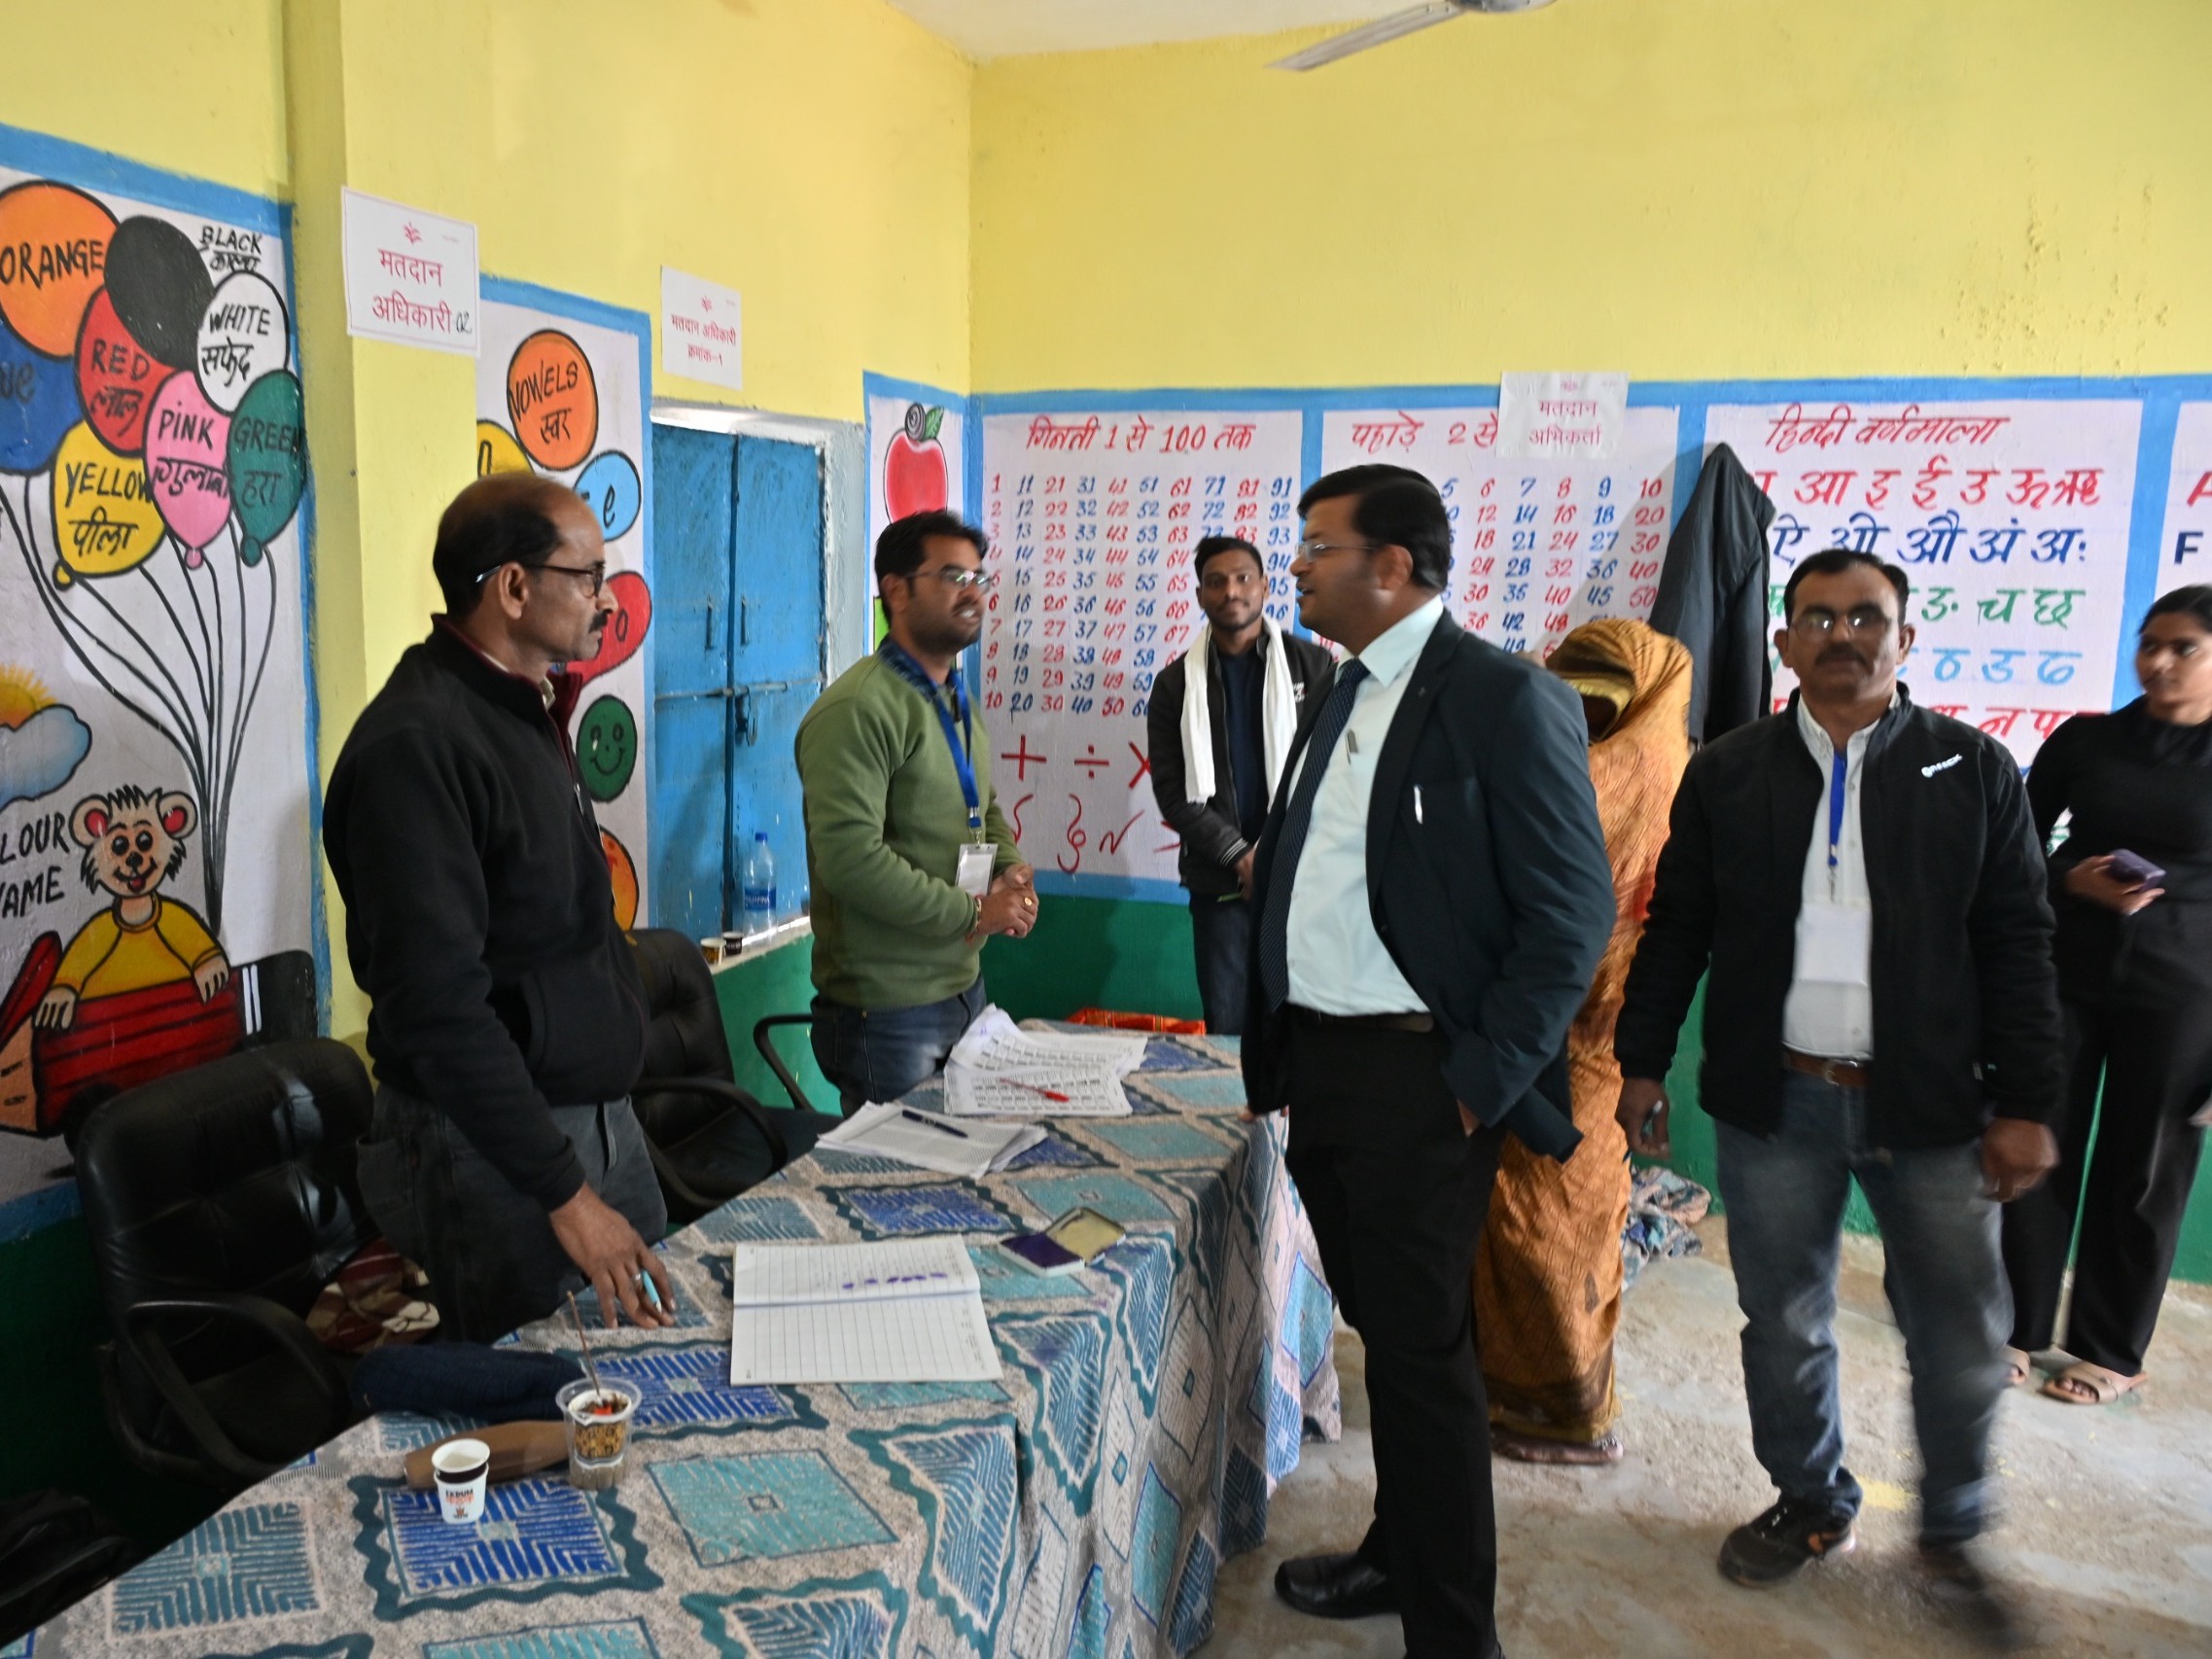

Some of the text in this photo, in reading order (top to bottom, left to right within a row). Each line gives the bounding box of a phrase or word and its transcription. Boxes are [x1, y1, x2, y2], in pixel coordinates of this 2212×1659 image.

[199, 226, 263, 254] BLACK
[0, 238, 104, 289] ORANGE
[377, 248, 443, 287] मतदान
[209, 303, 271, 335] WHITE
[372, 290, 452, 334] अधिकारी
[91, 338, 151, 381] RED
[509, 359, 579, 423] VOWELS
[90, 385, 144, 437] लाल
[541, 406, 573, 443] स्वर
[1539, 400, 1598, 417] मतदान
[234, 416, 305, 459] GREEN
[1026, 413, 1257, 453] गिनती 1 से 100 तक
[1352, 409, 1498, 454] पहाड़े 2 से
[1765, 402, 2011, 453] हिन्दी वर्णमाला
[64, 462, 153, 508] YELLOW
[242, 470, 283, 508] हरा
[1016, 475, 1034, 495] 11
[1044, 475, 1065, 494] 21
[1076, 476, 1096, 494] 31
[1139, 476, 1158, 493] 51
[1171, 476, 1192, 498] 61
[1205, 475, 1226, 496] 71
[1271, 476, 1292, 498] 91
[1441, 477, 1458, 499] 5
[1521, 477, 1536, 497] 7
[1557, 477, 1571, 499] 8
[1598, 476, 1611, 499] 9
[1640, 477, 1663, 499] 10
[1794, 471, 1858, 507] आ
[1865, 469, 1902, 511] इ
[1912, 454, 1953, 511] ई
[1960, 469, 2001, 505] उ
[1016, 499, 1034, 518] 12
[1044, 500, 1068, 517] 22
[1076, 499, 1097, 517] 32
[1106, 500, 1129, 517] 42
[1137, 501, 1160, 519] 52
[1169, 502, 1191, 520] 62
[1202, 501, 1225, 520] 72
[1234, 503, 1258, 521] 82
[1269, 502, 1291, 521] 92
[1477, 504, 1665, 526] 12 14 18 20
[67, 507, 139, 557] पीला
[1016, 522, 1290, 546] 13 23 33 43 53 63 93
[1474, 529, 1661, 554] 18 21 24 27 30
[1773, 513, 1810, 569] ऐ
[1897, 509, 1969, 564] औ
[1969, 516, 2026, 564] अं
[2175, 532, 2204, 564] F
[1015, 545, 1034, 562] 14
[1043, 546, 1066, 564] 24
[1073, 547, 1096, 565] 34
[1106, 547, 1129, 564] 44
[1137, 547, 1159, 566] 54
[1267, 552, 1291, 572] 94
[1469, 557, 1495, 576] 24
[1505, 557, 1531, 578] 28
[1545, 558, 1573, 578] 32
[1629, 560, 1659, 581] 40
[1072, 571, 1097, 590] 35
[1136, 573, 1158, 591] 55
[1463, 582, 1658, 609] 30 35 40 45 50
[1073, 594, 1097, 614] 36
[1136, 598, 1156, 618] 56
[1501, 612, 1525, 631] 42
[1977, 589, 2026, 624] च
[2033, 587, 2086, 630] छ
[1015, 619, 1033, 638] 17
[1043, 619, 1066, 637] 27
[1075, 620, 1098, 639] 37
[1104, 623, 1126, 640] 47
[1134, 624, 1157, 643] 57
[1013, 665, 1029, 685] 19
[1042, 668, 1064, 689] 29
[1071, 672, 1095, 690] 39
[1103, 672, 1124, 688] 49
[1933, 649, 1971, 682] ठ
[1982, 650, 2026, 684] ड
[986, 690, 1125, 717] 10 20 30 40 50
[1980, 707, 2029, 739] न
[0, 812, 70, 865] LOUR
